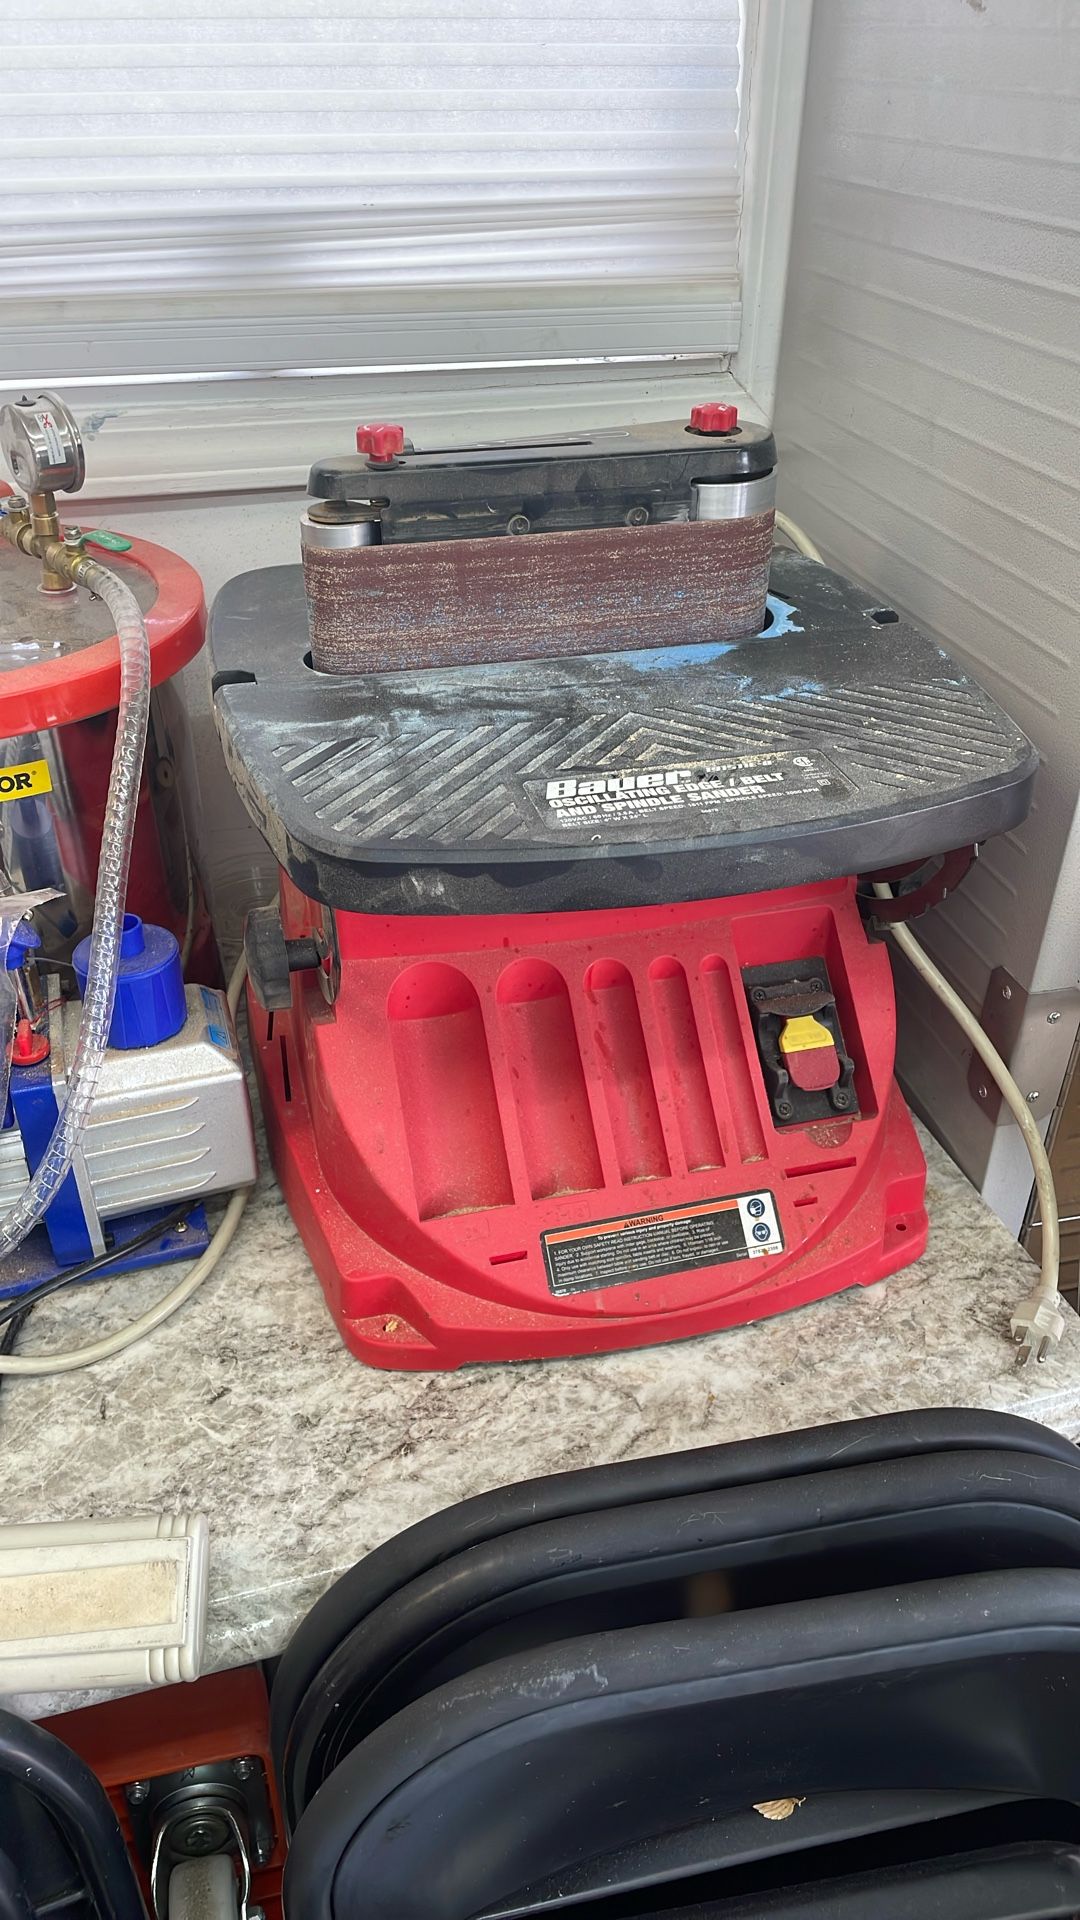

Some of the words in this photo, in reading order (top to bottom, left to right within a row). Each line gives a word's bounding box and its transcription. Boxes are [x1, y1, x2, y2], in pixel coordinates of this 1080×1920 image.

[546, 770, 691, 800] Bauer
[549, 786, 671, 808] OSCILLATING
[673, 780, 724, 793] EDGE
[740, 772, 784, 785] BELT
[556, 805, 597, 818] AND
[601, 794, 685, 812] SPINDLE
[687, 785, 766, 801] SANDER
[628, 1215, 663, 1226] WARNING
